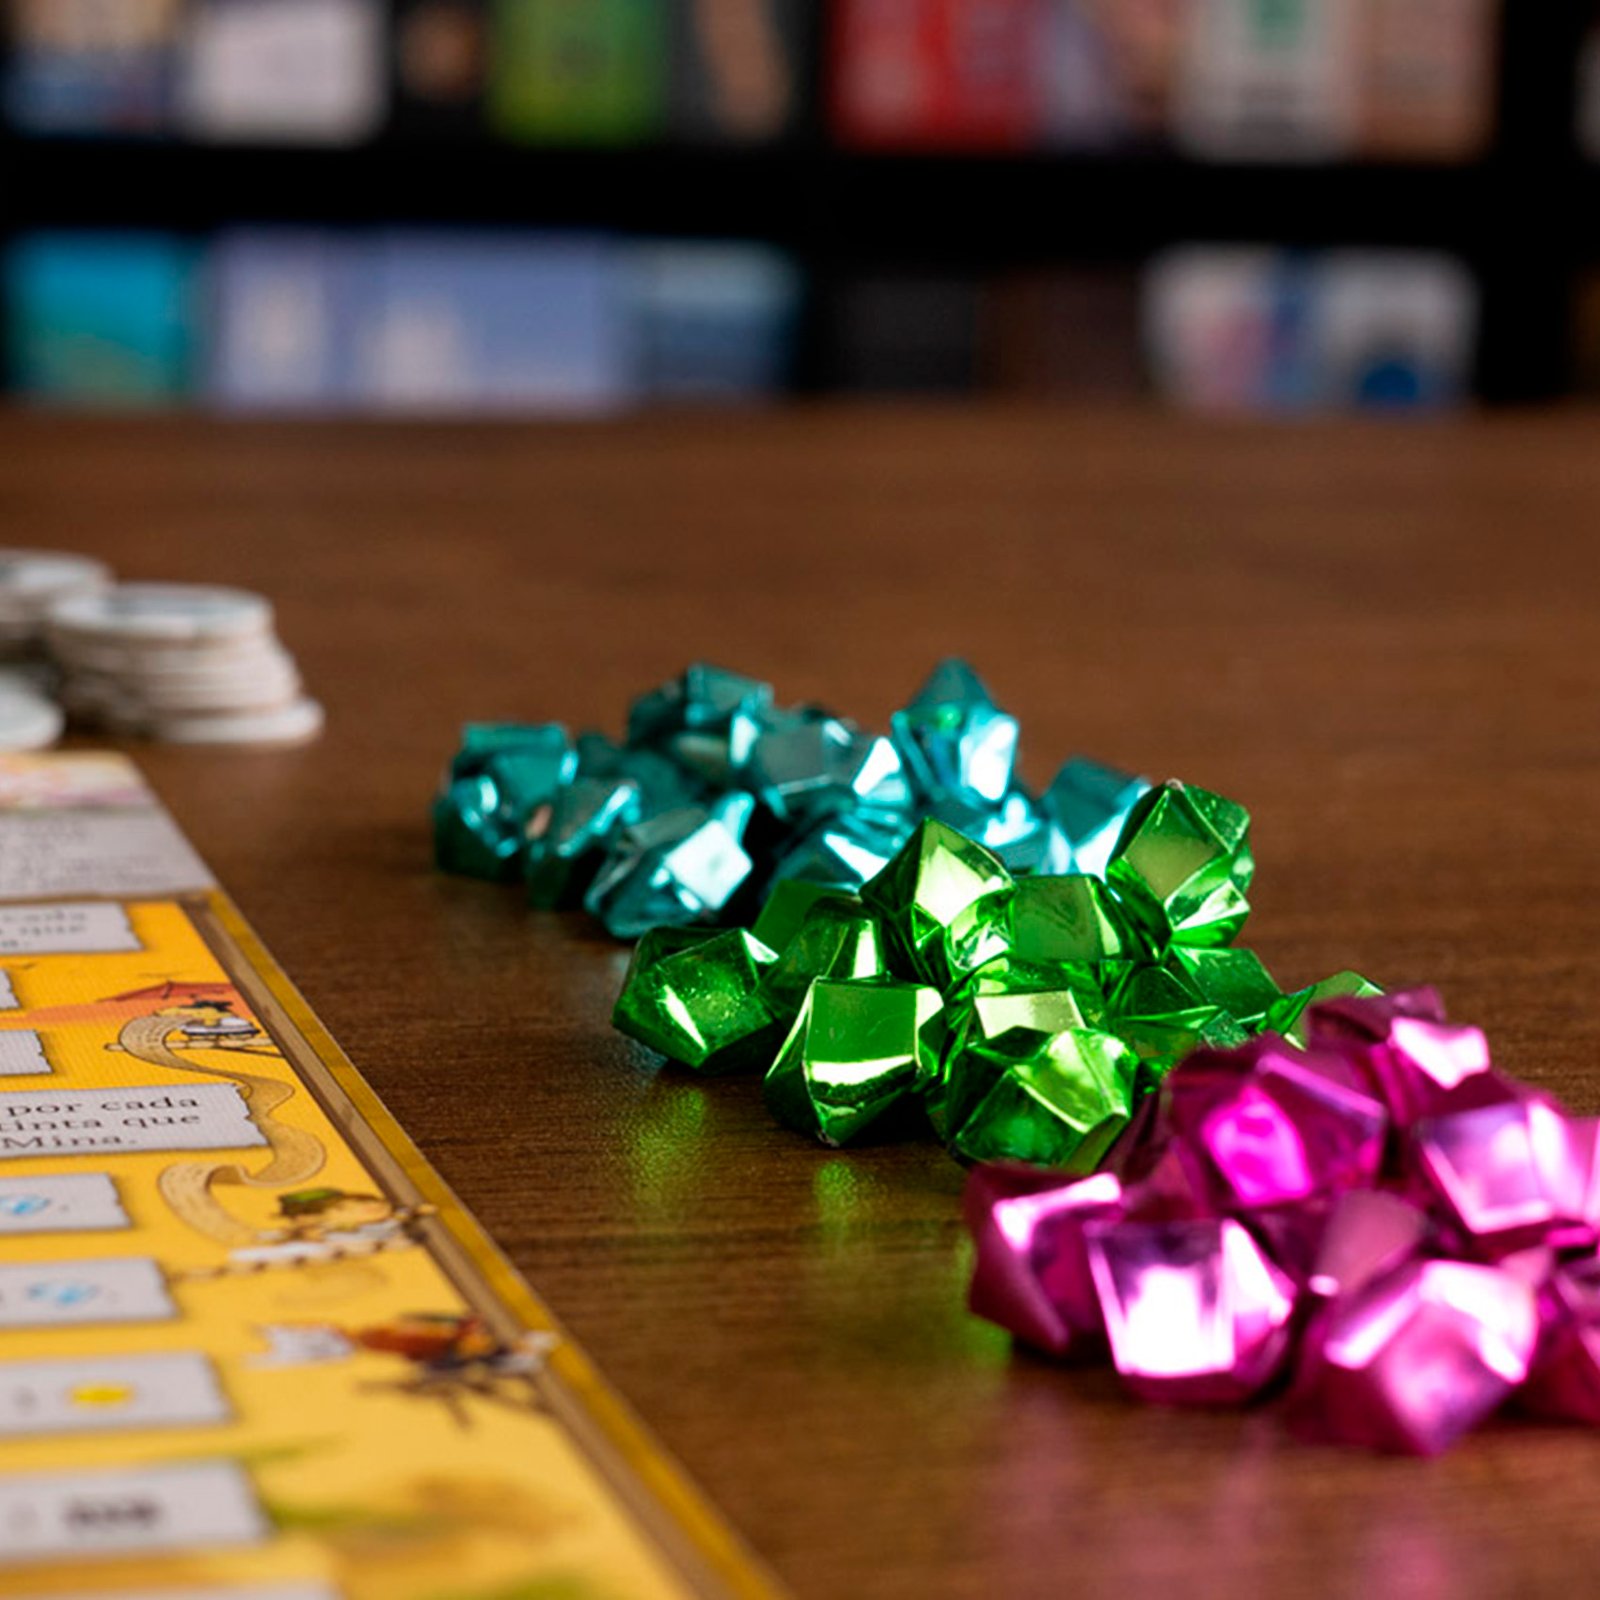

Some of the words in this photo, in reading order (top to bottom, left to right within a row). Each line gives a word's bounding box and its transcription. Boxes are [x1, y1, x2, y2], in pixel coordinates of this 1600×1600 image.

[7, 1103, 82, 1117] por
[101, 1096, 199, 1111] cada
[122, 1115, 200, 1129] que
[2, 1135, 138, 1148] Mina.
